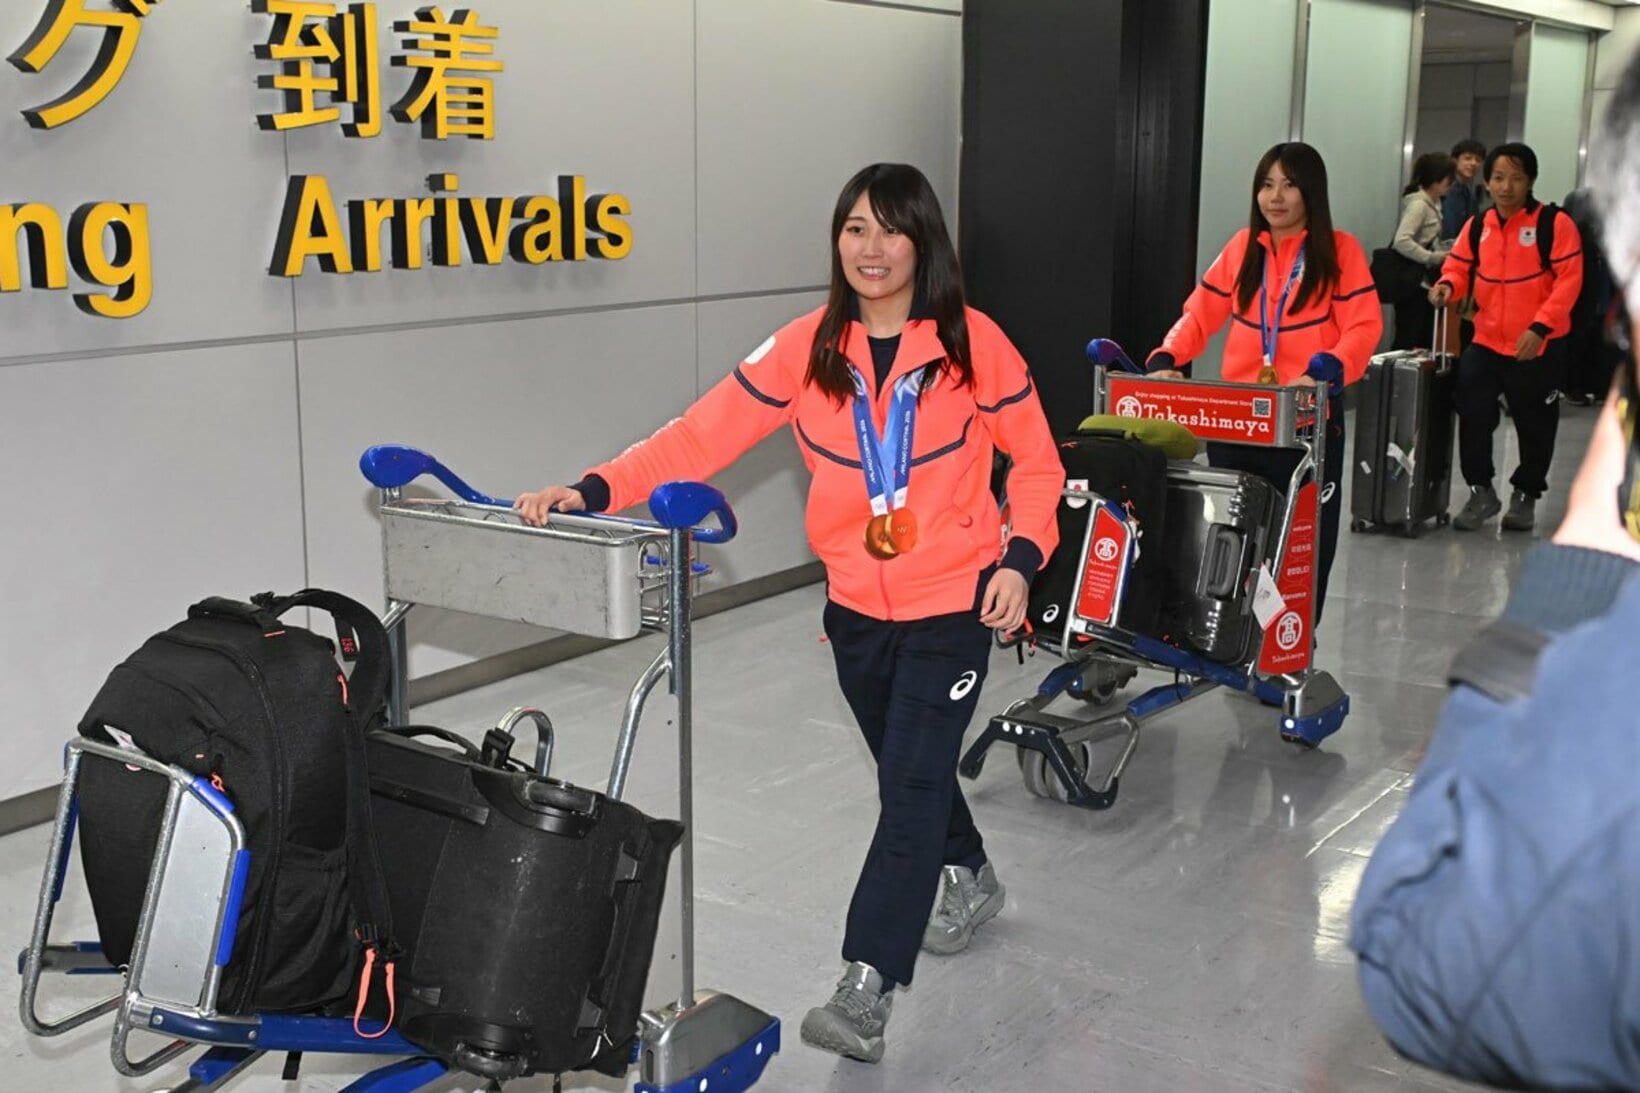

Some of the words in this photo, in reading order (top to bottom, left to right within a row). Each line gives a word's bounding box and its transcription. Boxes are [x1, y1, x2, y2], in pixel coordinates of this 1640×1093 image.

[251, 0, 504, 140] 到着
[0, 200, 153, 318] ng
[268, 173, 635, 277] Arrivals
[1144, 403, 1270, 437] Takashimaya
